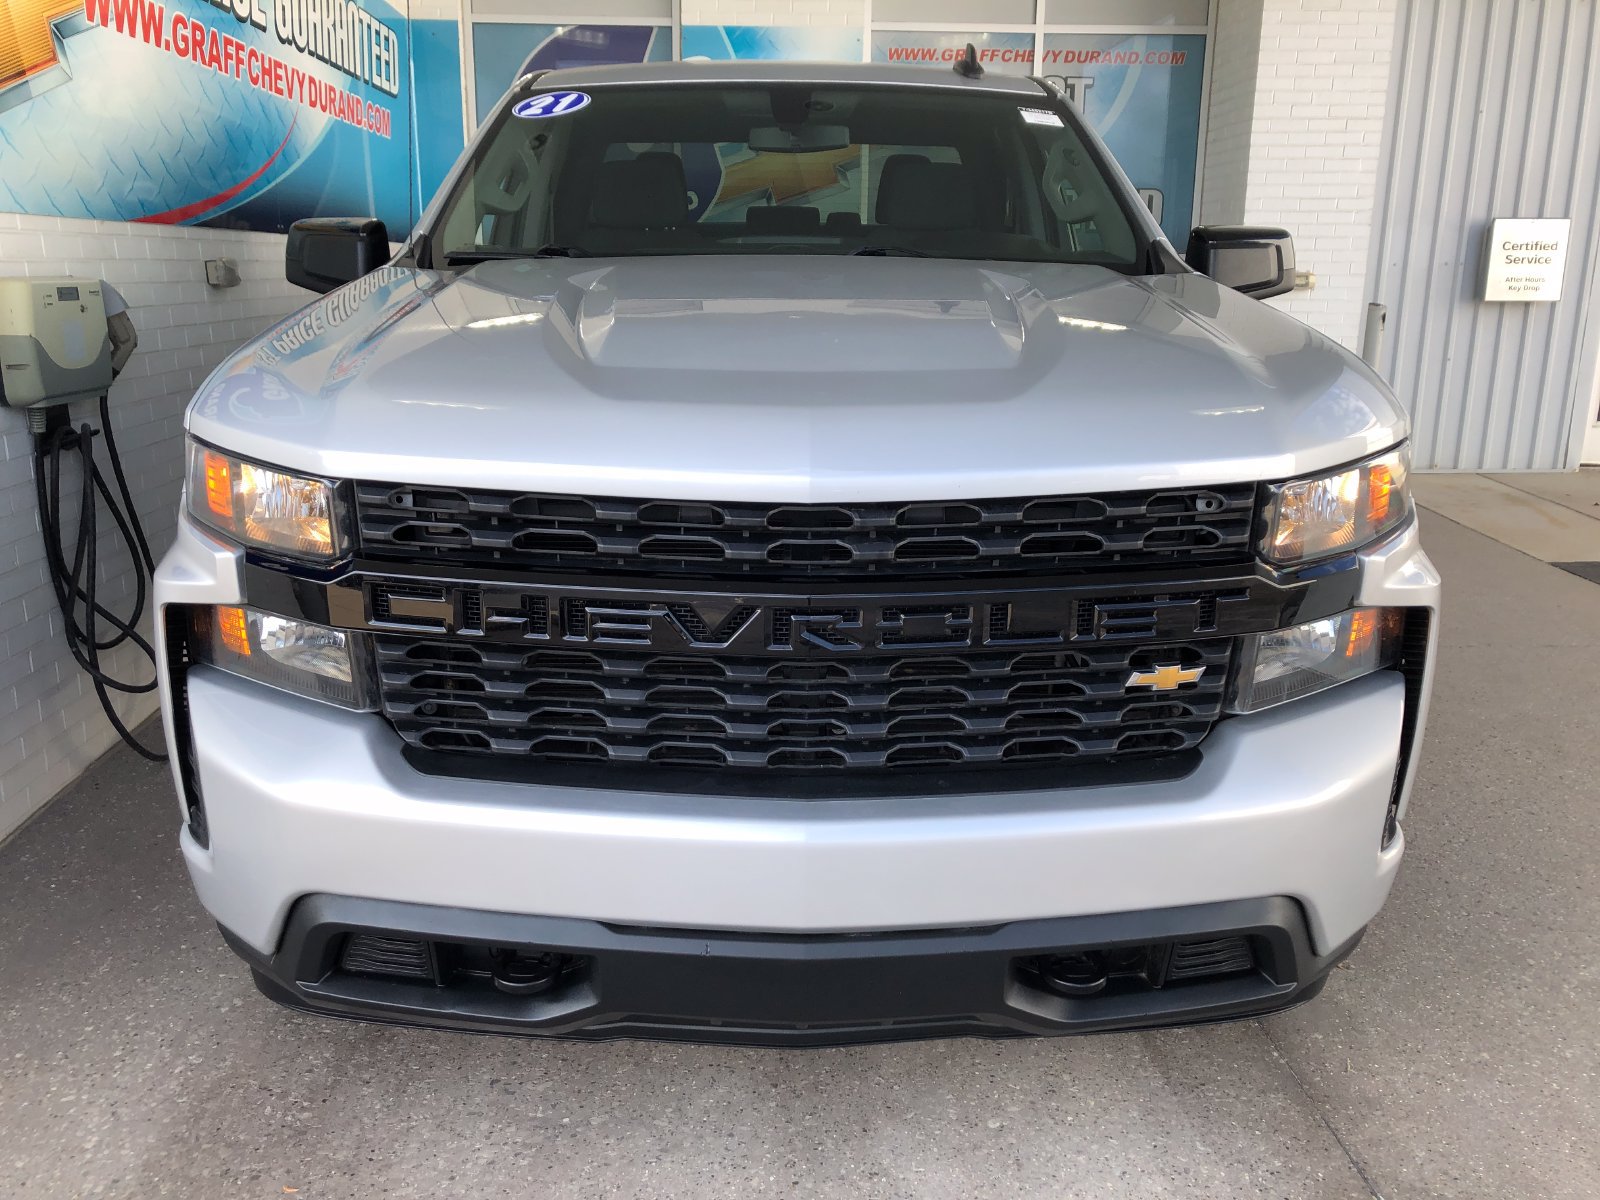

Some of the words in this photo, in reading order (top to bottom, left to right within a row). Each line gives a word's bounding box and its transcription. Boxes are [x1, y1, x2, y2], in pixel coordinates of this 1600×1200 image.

[888, 47, 1187, 65] WWW.GRFFCHEVYDURAND.COM
[520, 93, 579, 116] 21
[1502, 241, 1558, 251] Certified
[1504, 254, 1552, 265] Service
[363, 581, 1250, 650] CHEVROLET
